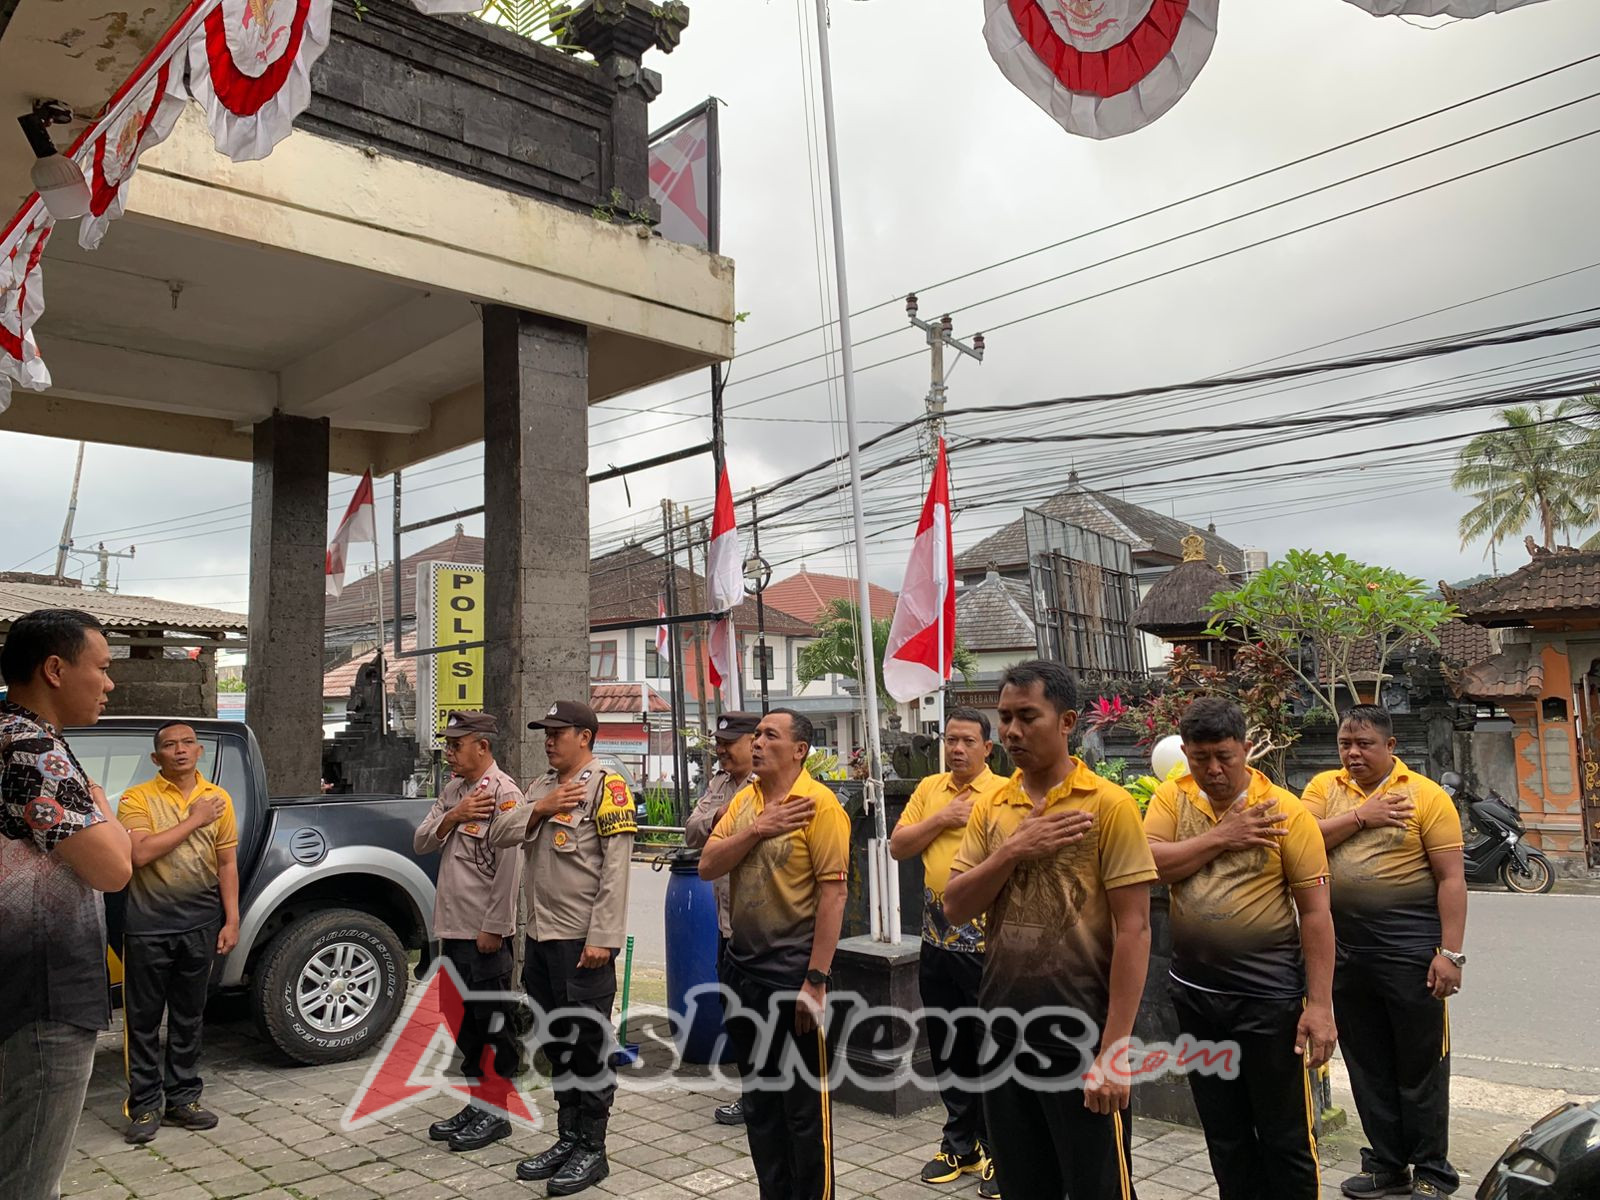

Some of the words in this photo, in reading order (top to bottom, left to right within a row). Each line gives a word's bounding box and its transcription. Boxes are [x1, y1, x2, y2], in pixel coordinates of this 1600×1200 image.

[450, 573, 475, 700] POLISI
[969, 694, 999, 704] BEBAND
[312, 929, 397, 999] BRIDGESTONE
[292, 1022, 368, 1048] DUELER
